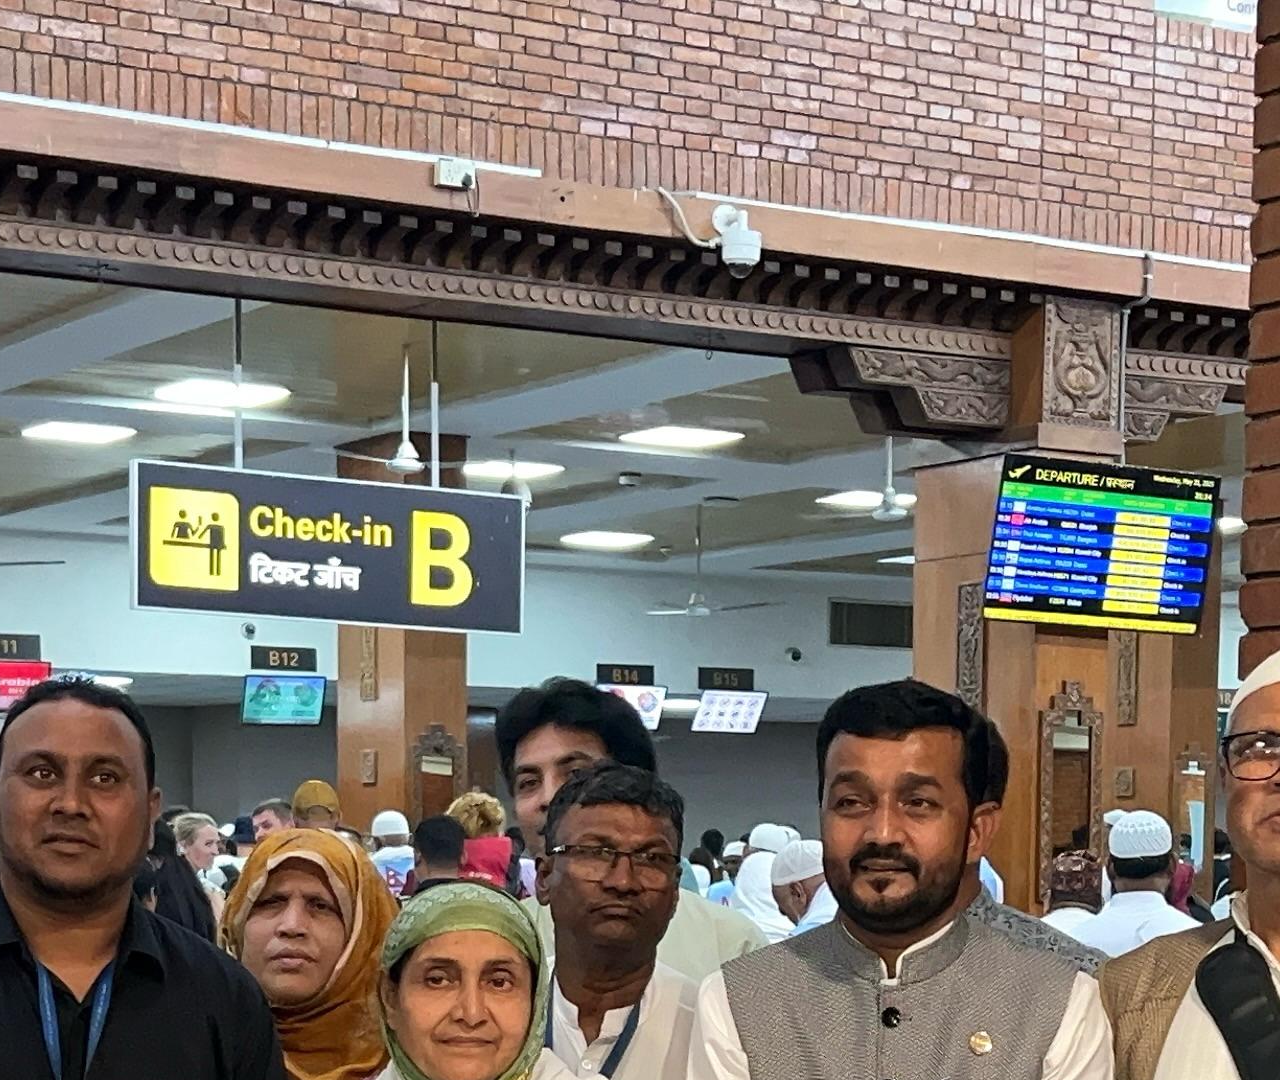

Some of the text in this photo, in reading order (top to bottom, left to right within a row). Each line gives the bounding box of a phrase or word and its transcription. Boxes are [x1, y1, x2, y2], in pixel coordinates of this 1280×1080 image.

[1035, 468, 1099, 487] DEPARTURE
[248, 504, 393, 548] Check-in
[249, 552, 362, 592] टिकट जाँच
[410, 510, 475, 607] B
[269, 650, 299, 666] B12
[612, 668, 639, 684] B14
